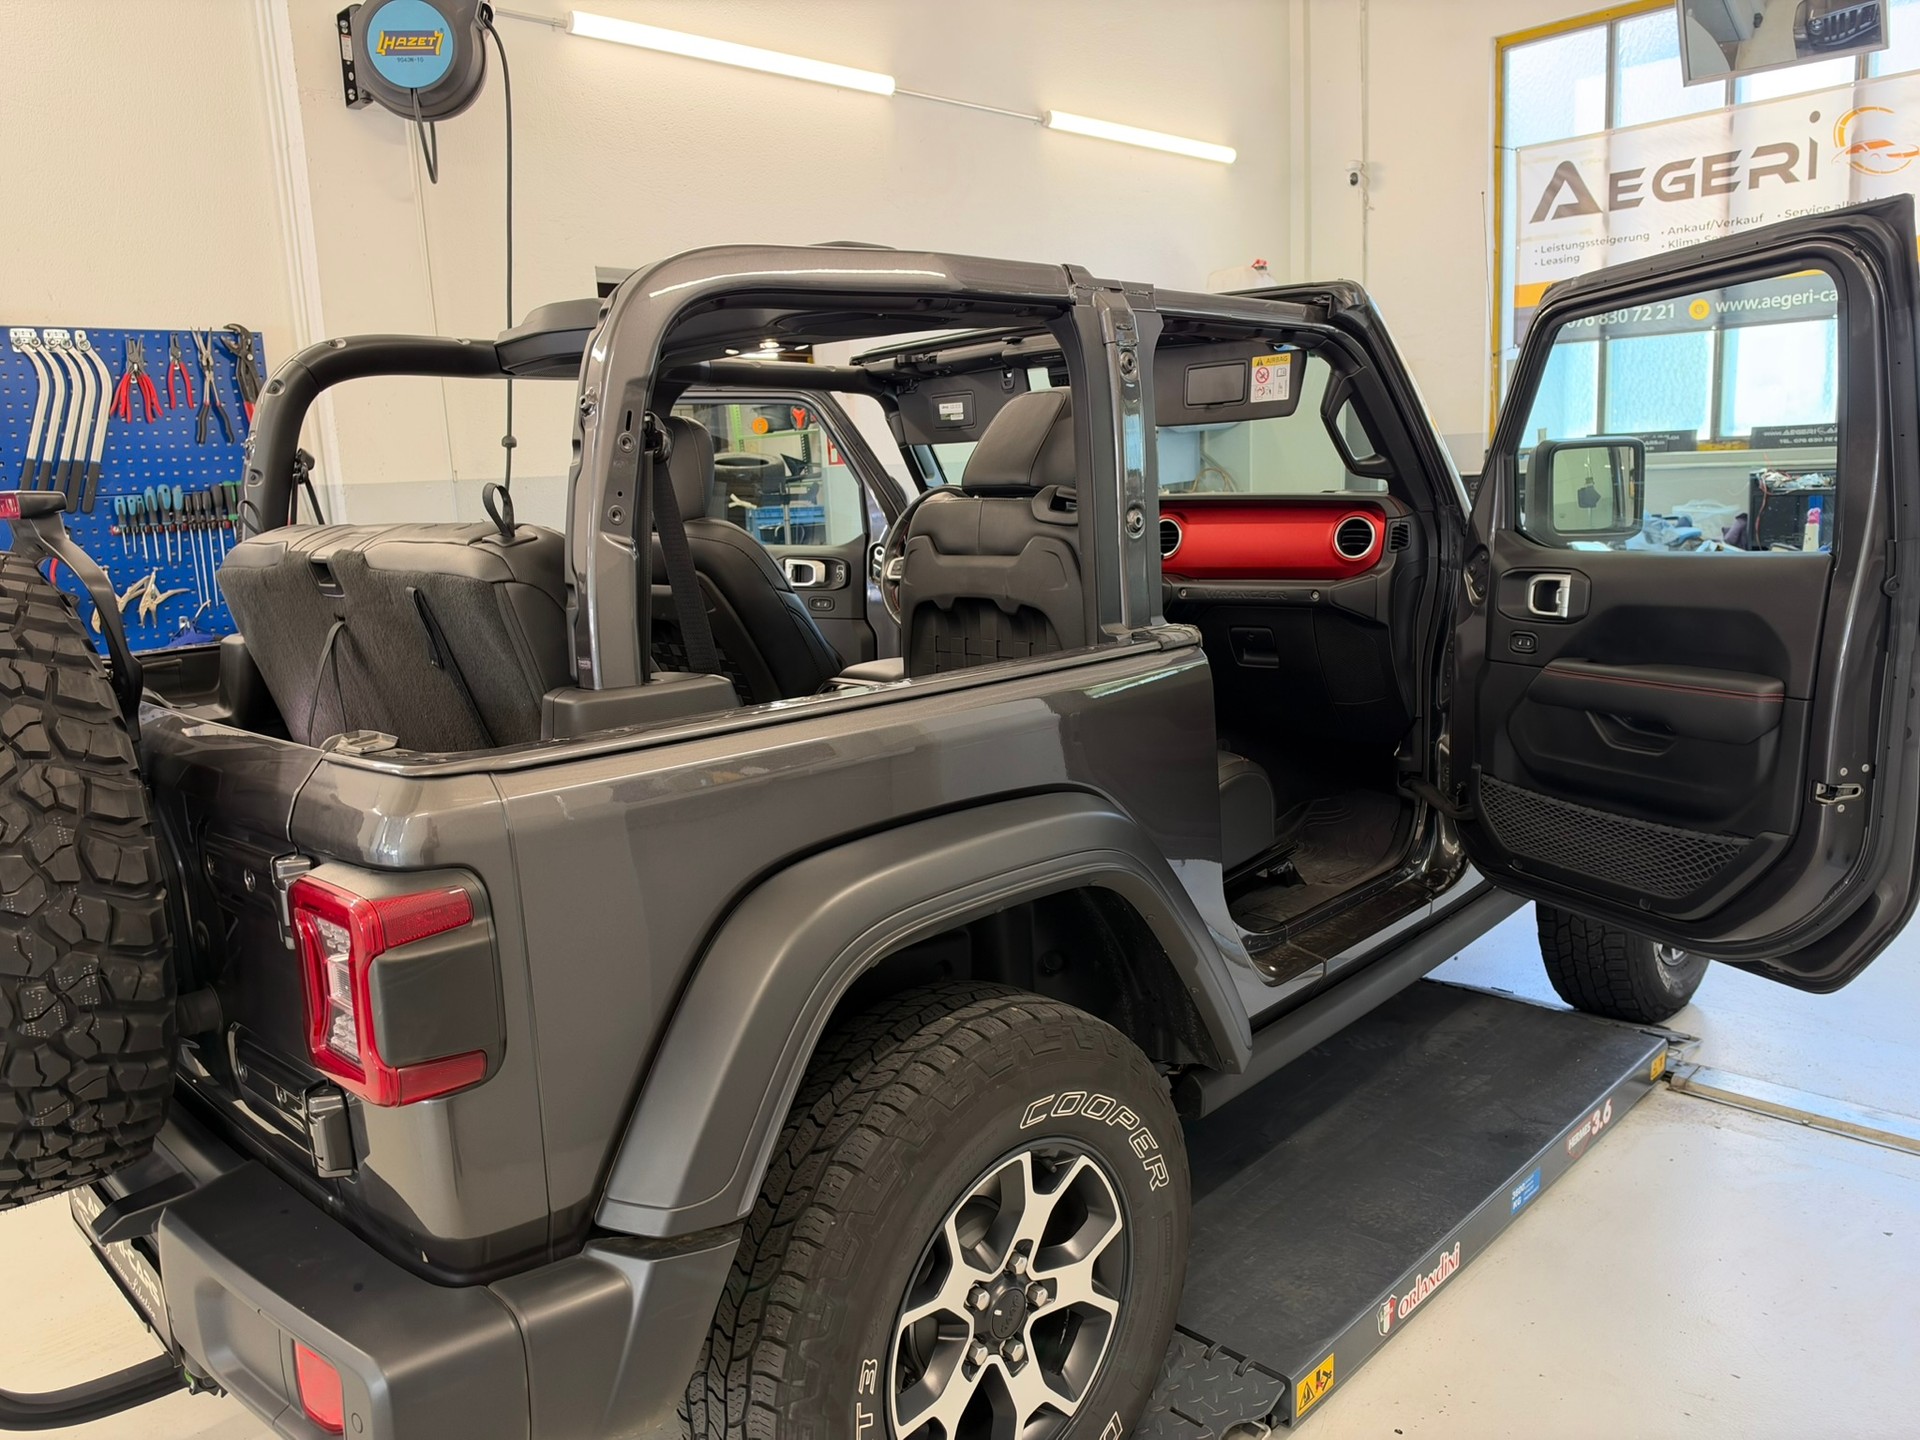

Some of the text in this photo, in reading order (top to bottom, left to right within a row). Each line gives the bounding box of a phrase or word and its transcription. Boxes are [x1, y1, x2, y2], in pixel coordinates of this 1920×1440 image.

[382, 35, 437, 50] HAZET
[1784, 204, 1831, 219] Service
[1667, 213, 1764, 236] Ankauf/Verkauf
[1540, 232, 1650, 254] Leistungssteigerung
[1540, 254, 1580, 267] Leasing
[1715, 288, 1838, 313] www.aegeri-ca
[1598, 309, 1628, 325] 830
[1632, 305, 1652, 322] 72
[1656, 303, 1675, 320] 21
[1266, 355, 1288, 364] AIRBAG
[1591, 1098, 1612, 1136] 3.6
[1020, 1090, 1170, 1191] COOPER
